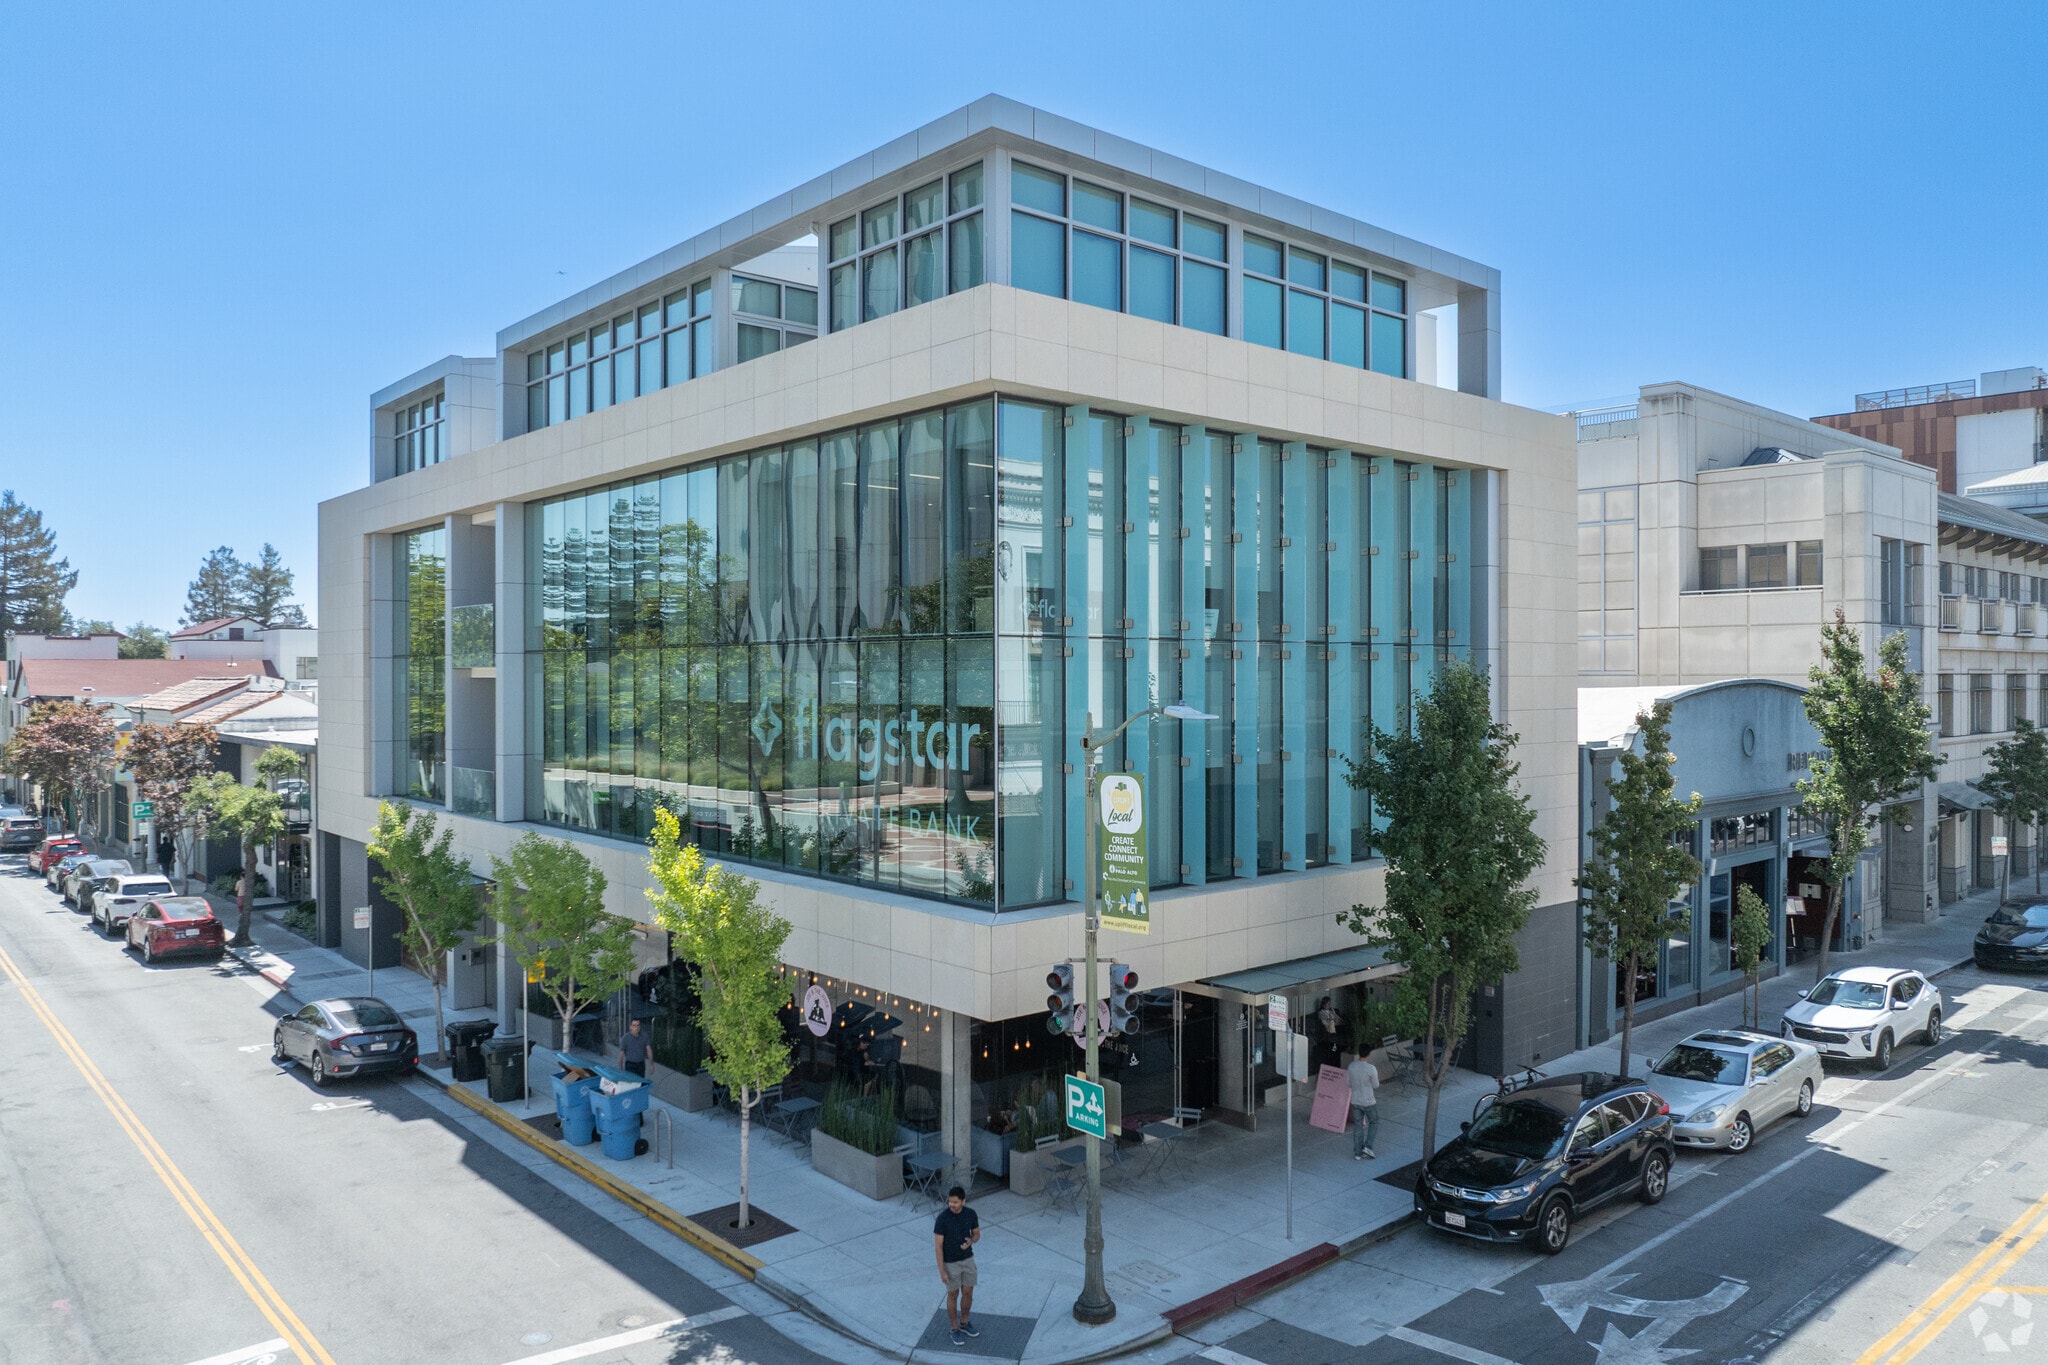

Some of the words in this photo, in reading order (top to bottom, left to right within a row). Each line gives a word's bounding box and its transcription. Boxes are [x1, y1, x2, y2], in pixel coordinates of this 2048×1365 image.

[794, 697, 981, 782] flagstar
[135, 804, 145, 816] P
[1107, 808, 1134, 826] Local
[808, 799, 899, 833] PRIVATE
[909, 808, 980, 844] BANK
[1111, 836, 1135, 846] CREATE
[1108, 844, 1138, 855] CONNECT
[1104, 852, 1144, 864] COMMUNITY
[1067, 1083, 1085, 1119] P
[1075, 1112, 1099, 1128] ARKING
